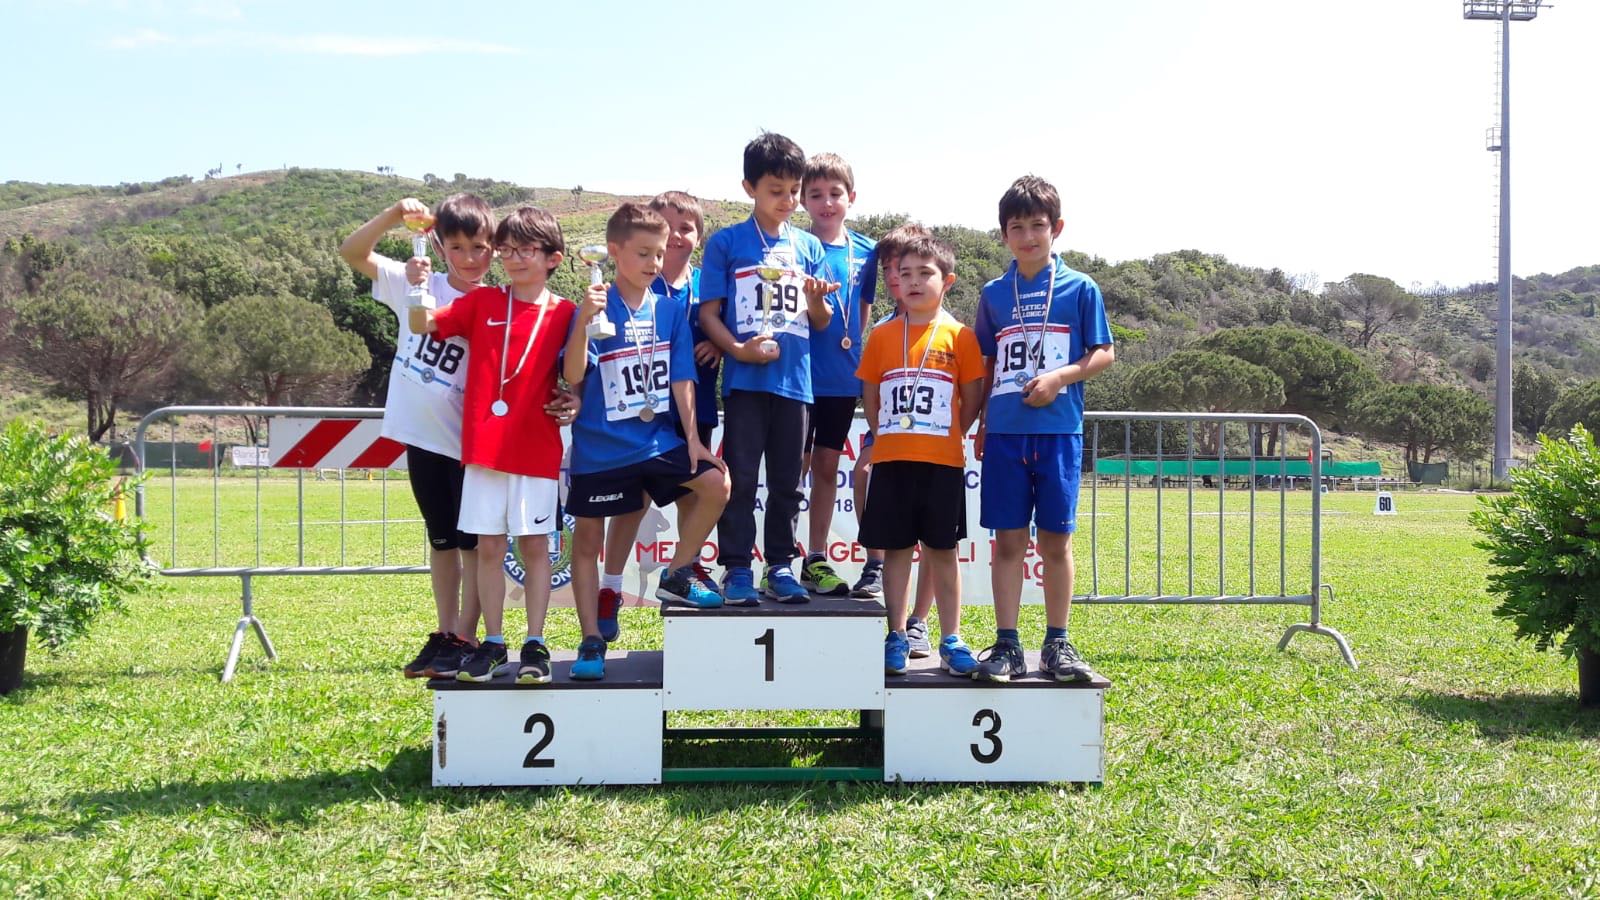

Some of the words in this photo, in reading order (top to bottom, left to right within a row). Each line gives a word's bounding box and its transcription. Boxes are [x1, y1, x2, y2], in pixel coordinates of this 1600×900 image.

[414, 333, 465, 375] 198
[1003, 341, 1045, 373] 194
[621, 360, 669, 396] 192
[891, 384, 934, 415] 193
[588, 492, 623, 502] LEGEA
[1379, 496, 1391, 511] 60
[754, 628, 774, 682] 1
[523, 713, 555, 768] 2
[970, 708, 1003, 764] 3
